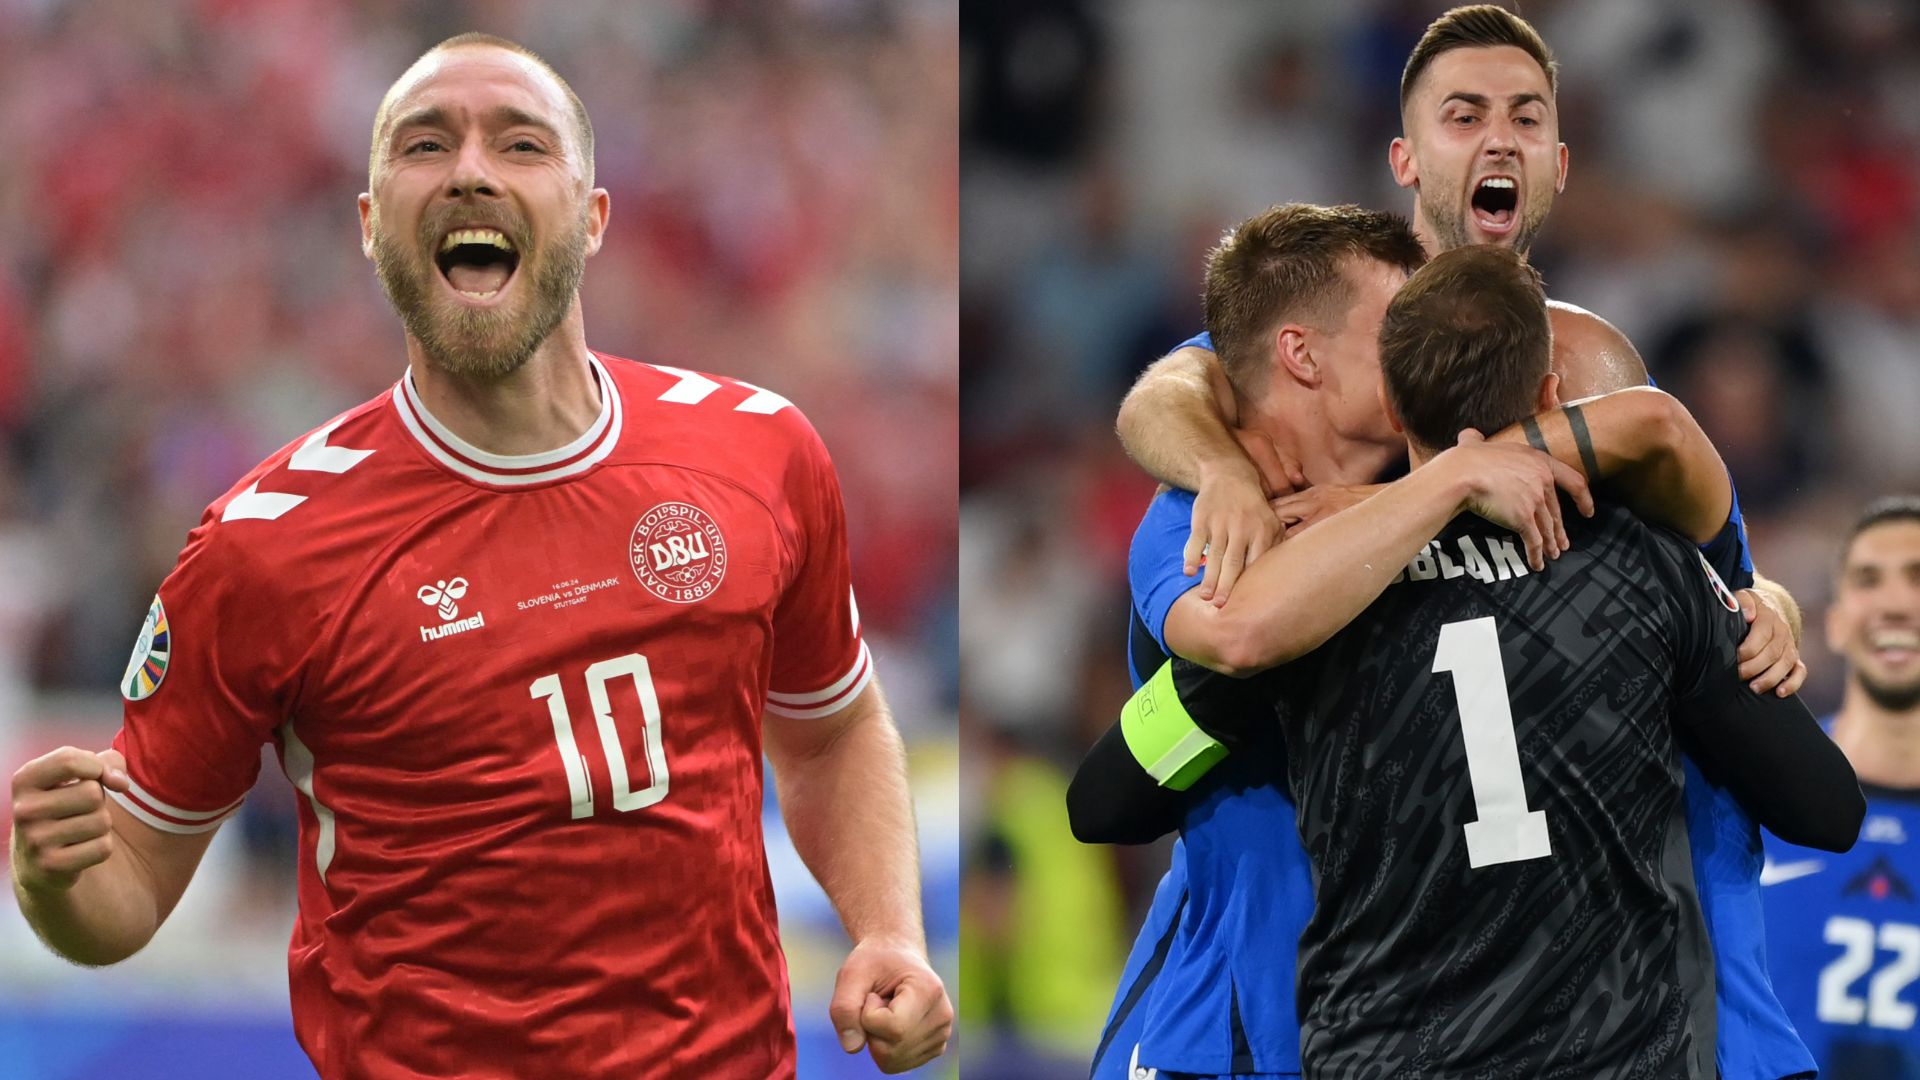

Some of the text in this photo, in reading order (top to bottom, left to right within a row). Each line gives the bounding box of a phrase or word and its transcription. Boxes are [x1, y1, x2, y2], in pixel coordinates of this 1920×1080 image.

[633, 542, 668, 596] DANSK
[675, 580, 712, 600] 1889
[649, 531, 709, 572] DBU
[1391, 534, 1529, 585] BLAK
[517, 592, 561, 610] SLOVENIA
[574, 577, 619, 595] DENMARK
[552, 579, 579, 590] 16.06.24
[553, 596, 587, 609] STUTTGART
[420, 611, 485, 642] hummel
[529, 653, 670, 820] 10
[1431, 616, 1552, 869] 1
[1817, 915, 1920, 1030] 22
